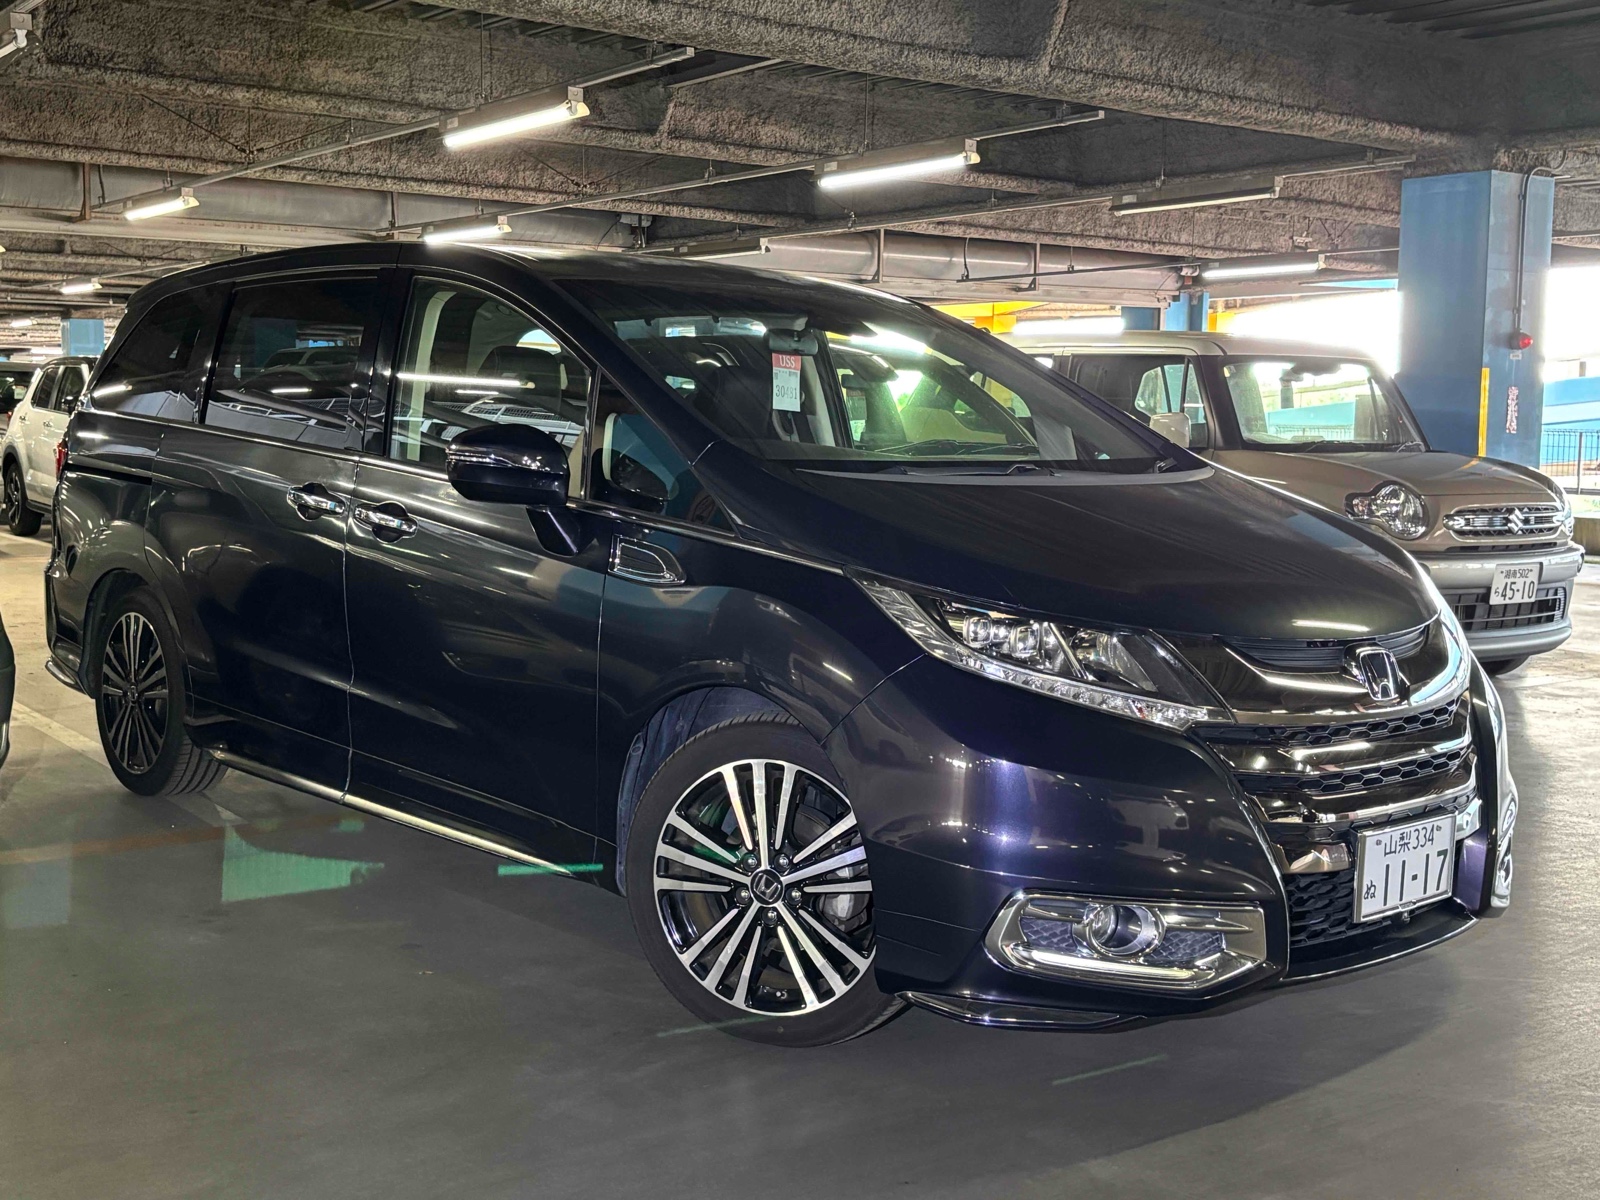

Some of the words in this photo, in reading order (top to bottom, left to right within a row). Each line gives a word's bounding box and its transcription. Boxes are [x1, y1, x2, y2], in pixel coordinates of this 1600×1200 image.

[779, 354, 795, 368] USS
[1384, 824, 1435, 857] 山梨334
[1363, 879, 1377, 900] ぬ
[1383, 848, 1449, 907] 11-17
